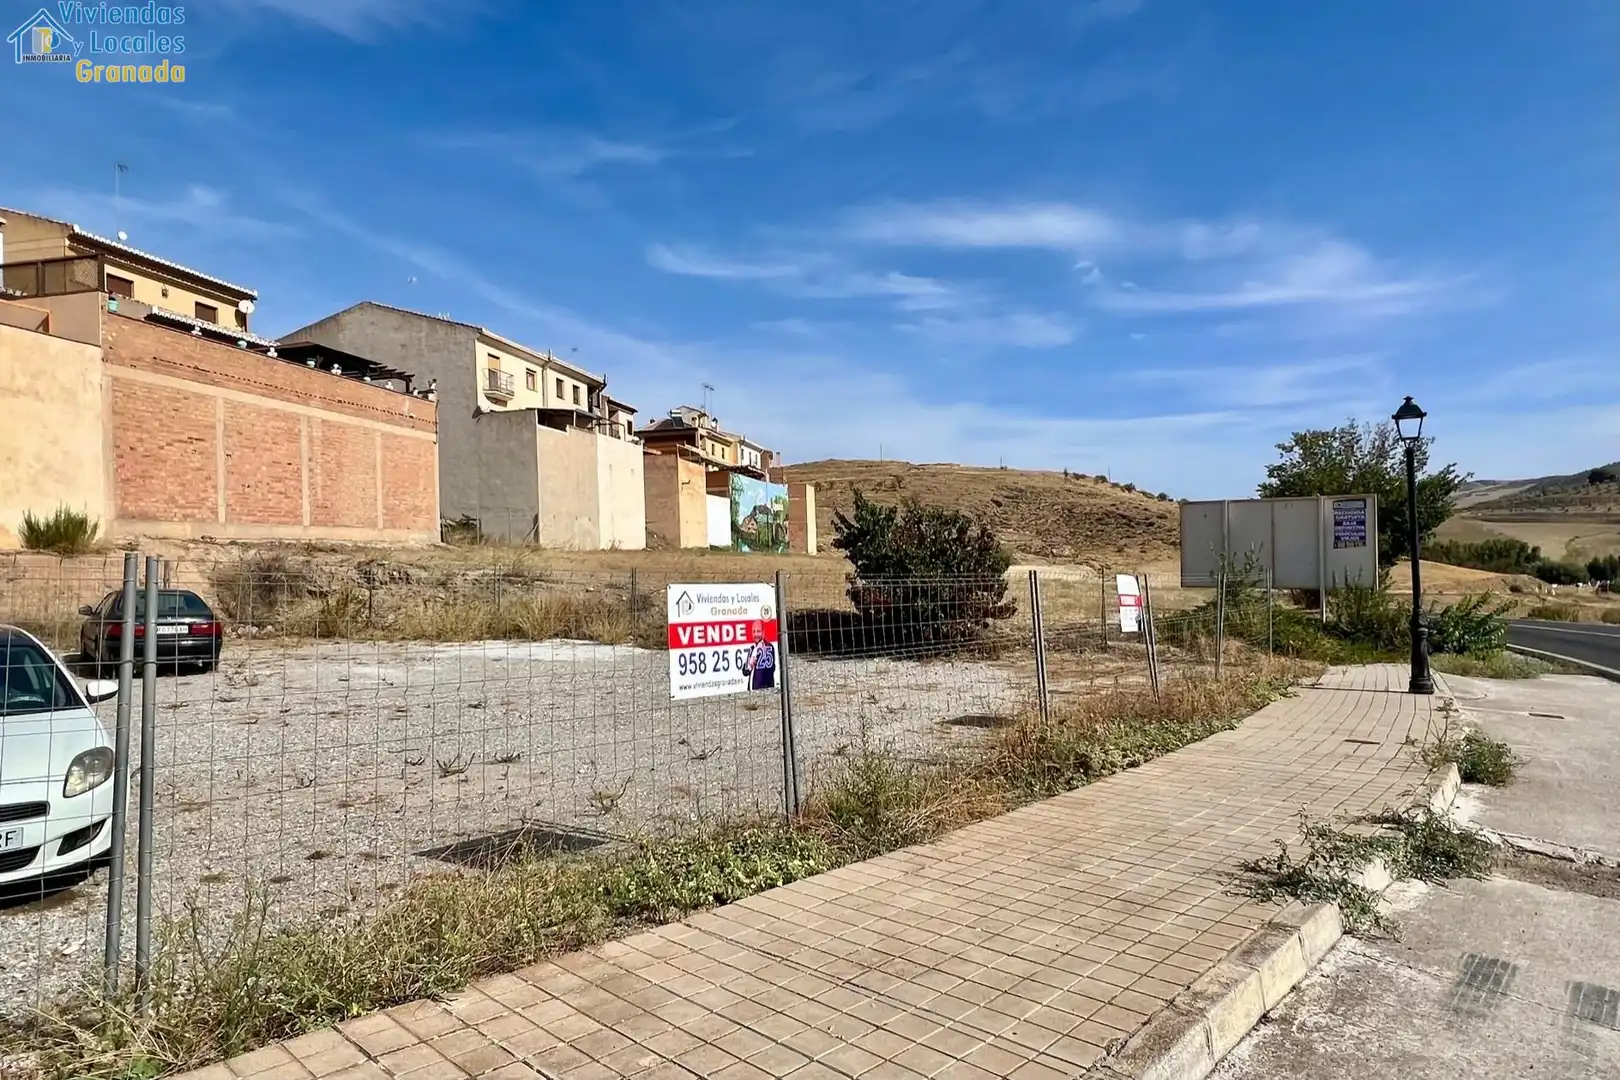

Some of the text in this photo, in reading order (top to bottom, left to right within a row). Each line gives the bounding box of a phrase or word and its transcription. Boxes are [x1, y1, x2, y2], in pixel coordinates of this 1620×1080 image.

[696, 592, 729, 604] Viviendas
[736, 592, 760, 603] Locales
[710, 606, 748, 616] Granada
[677, 623, 747, 645] VENDE
[678, 652, 707, 676] 958
[712, 650, 730, 673] 25
[756, 646, 773, 669] 25
